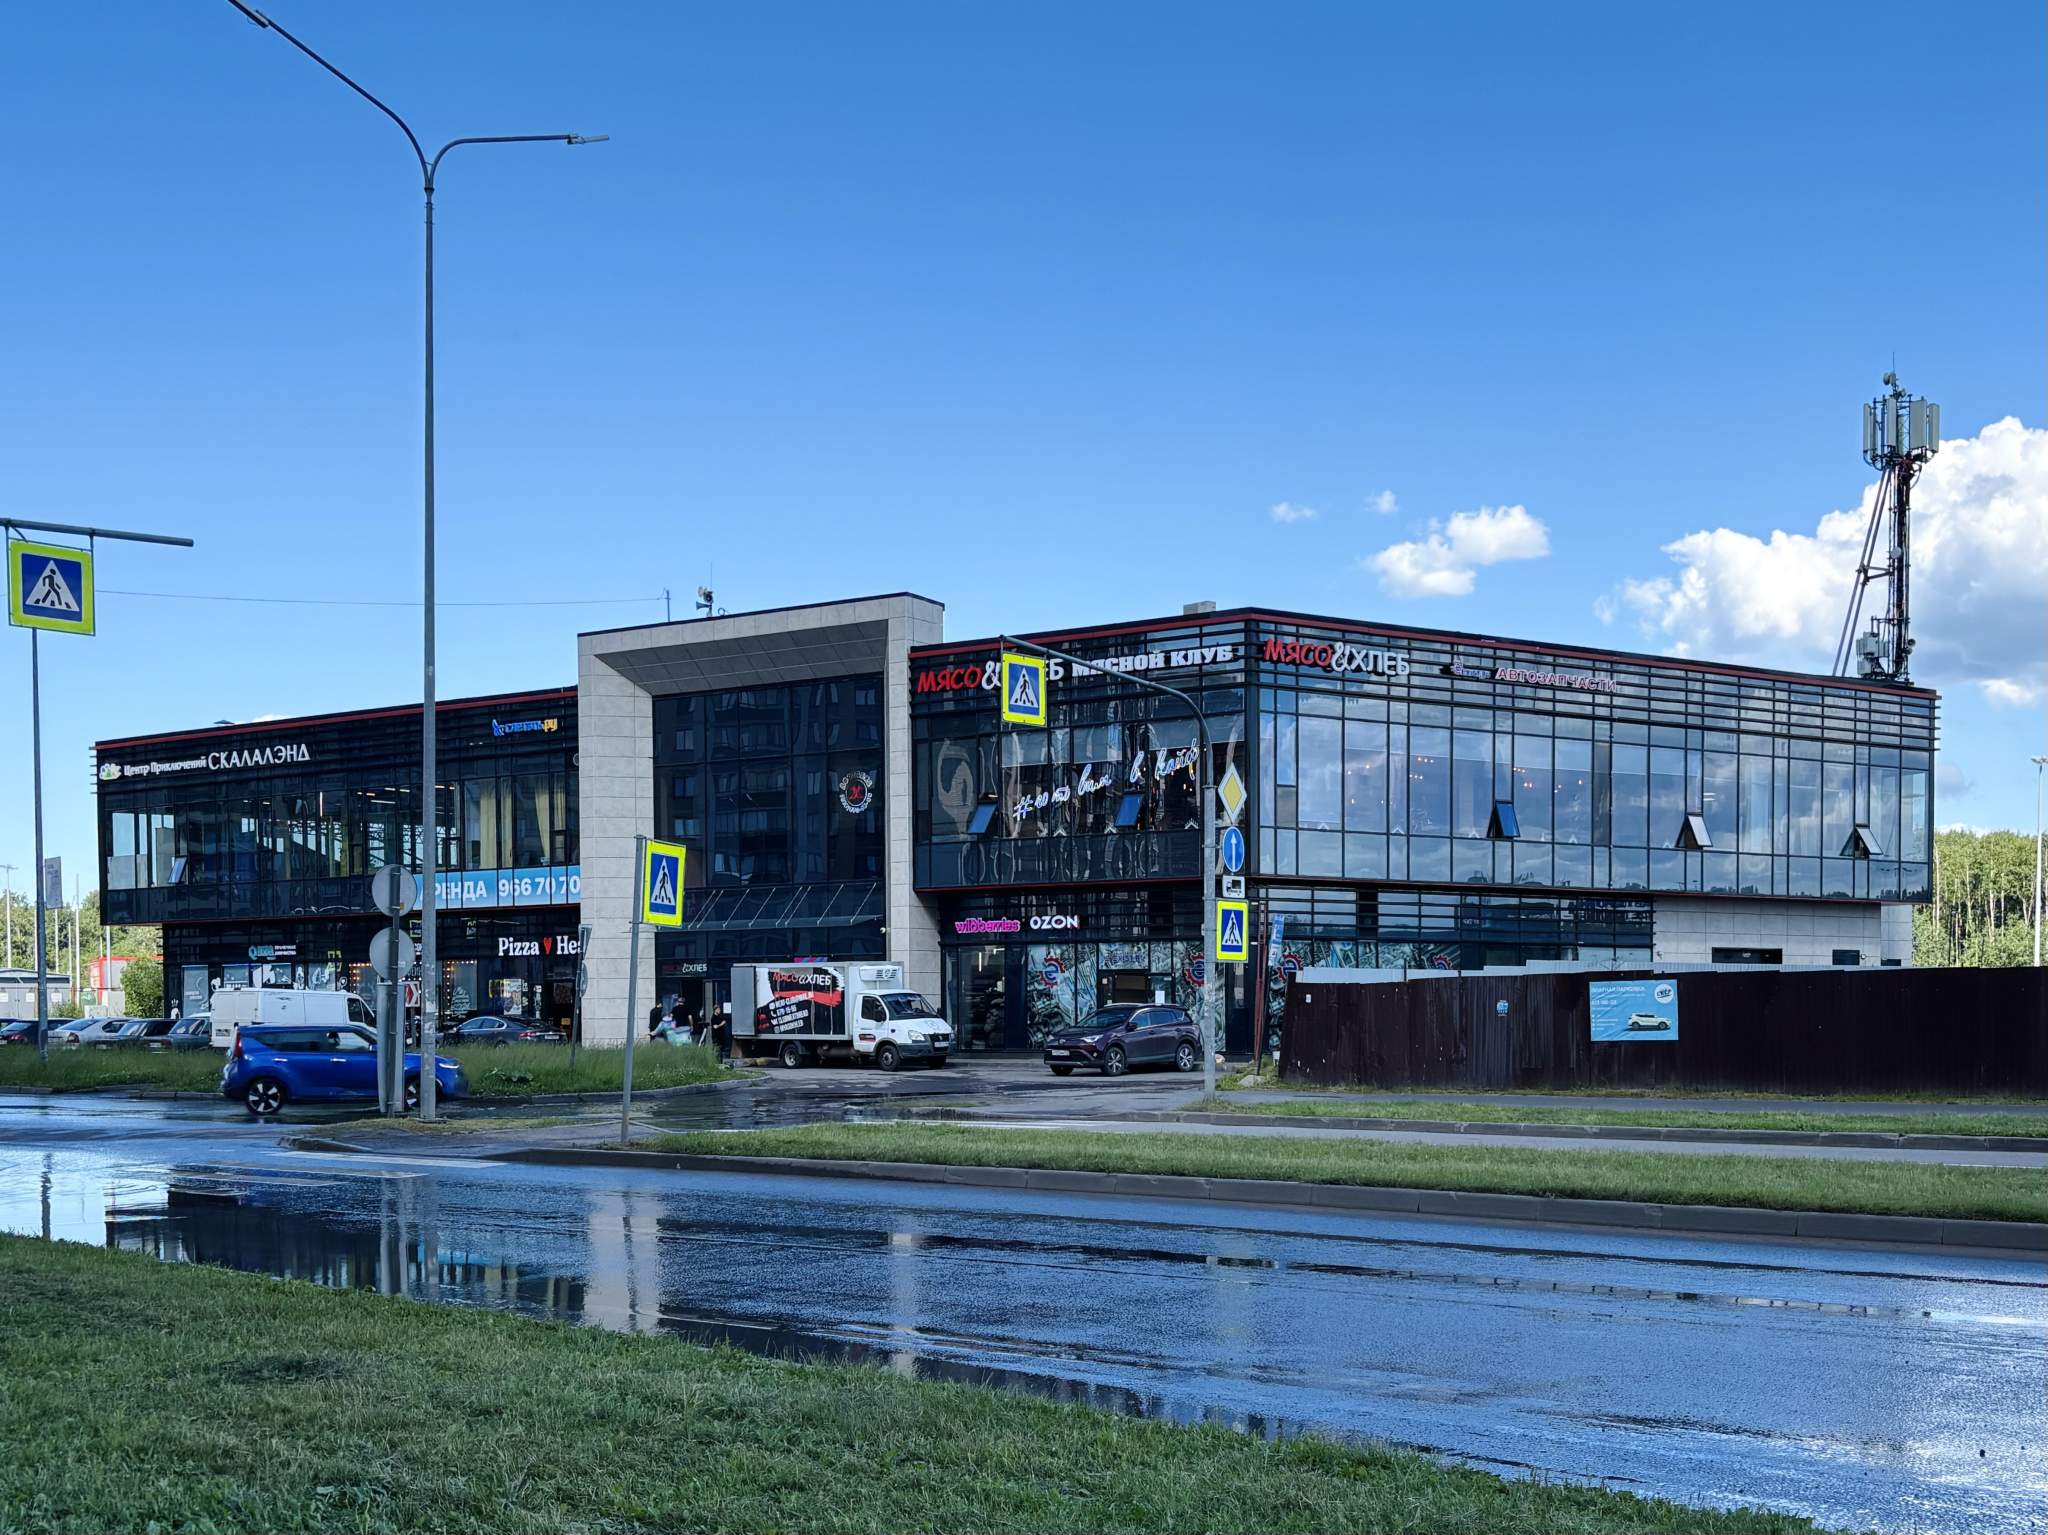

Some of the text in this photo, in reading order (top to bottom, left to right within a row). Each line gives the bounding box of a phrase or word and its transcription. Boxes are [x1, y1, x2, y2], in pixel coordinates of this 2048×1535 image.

[1170, 645, 1234, 668] КЛУБ
[1263, 639, 1411, 676] МЯСО&ХЛЕБ
[1496, 667, 1617, 693] АВТОЗАПЧАСТИ
[123, 743, 311, 777] Центр Приключений СКАЛАЛЭНД
[420, 875, 581, 902] РЕНДА 966 70 70
[954, 916, 1021, 934] wildberries
[1029, 914, 1080, 930] OZON
[498, 936, 540, 957] Pizza
